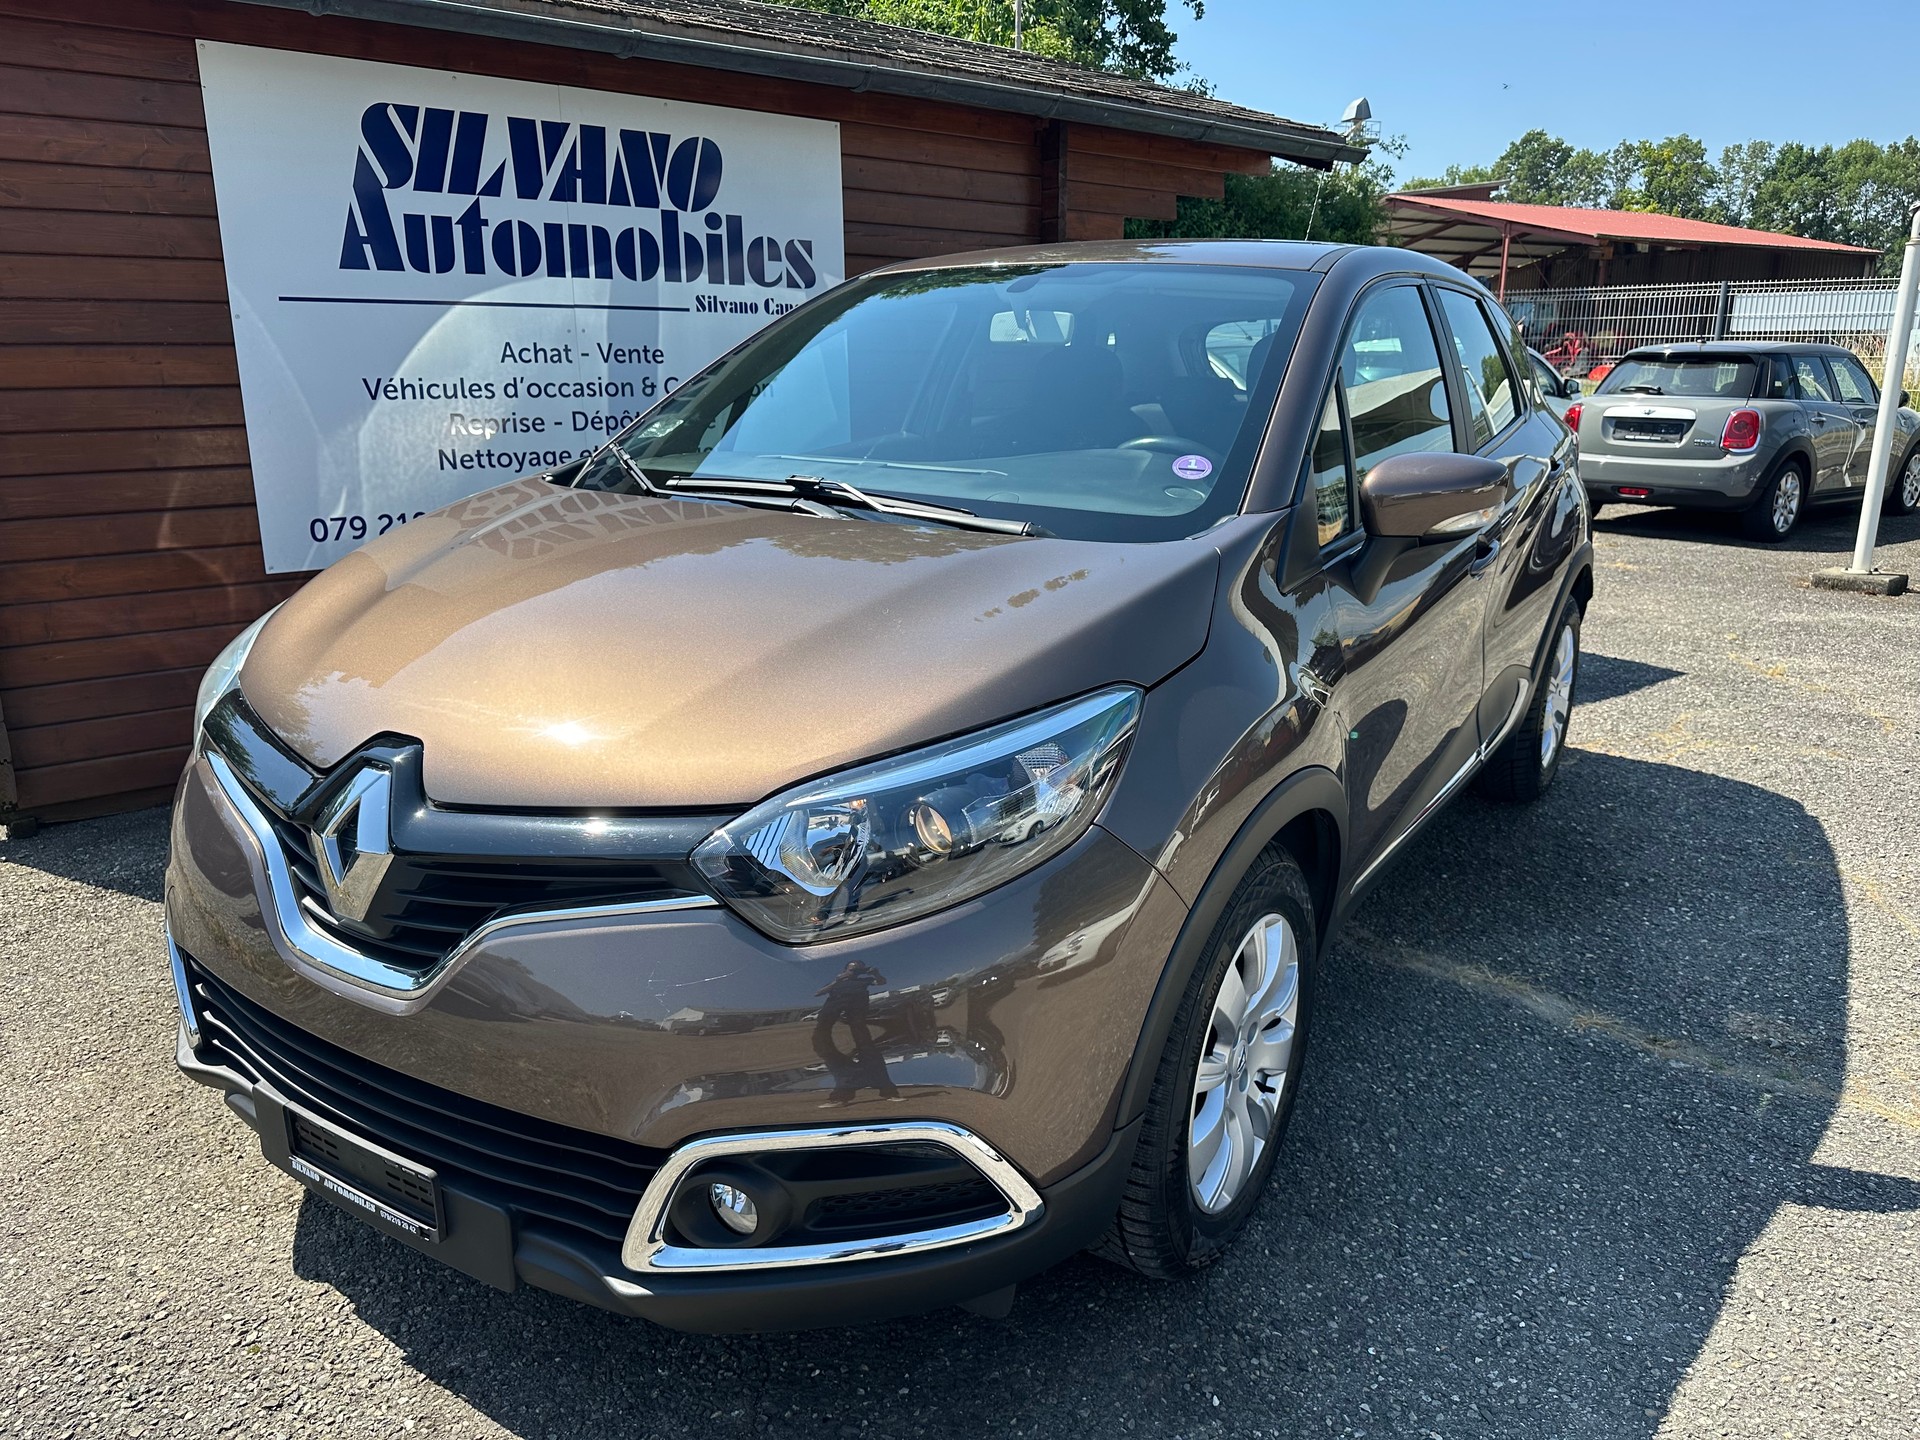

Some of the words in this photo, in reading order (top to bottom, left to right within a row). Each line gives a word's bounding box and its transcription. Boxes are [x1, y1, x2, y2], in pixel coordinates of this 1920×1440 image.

[353, 102, 723, 213] SILVANO
[339, 187, 817, 289] Automobiles
[695, 294, 759, 315] Silvano
[500, 341, 573, 364] Achat
[596, 341, 665, 365] Vente
[361, 377, 496, 401] Véhicules
[641, 377, 657, 398] &
[449, 413, 546, 440] Reprise
[438, 448, 572, 473] Nettoyage
[1187, 459, 1198, 469] 1
[309, 515, 368, 543] 079
[291, 1159, 320, 1182] SILVANO
[323, 1178, 376, 1213] AUTOMOBILES
